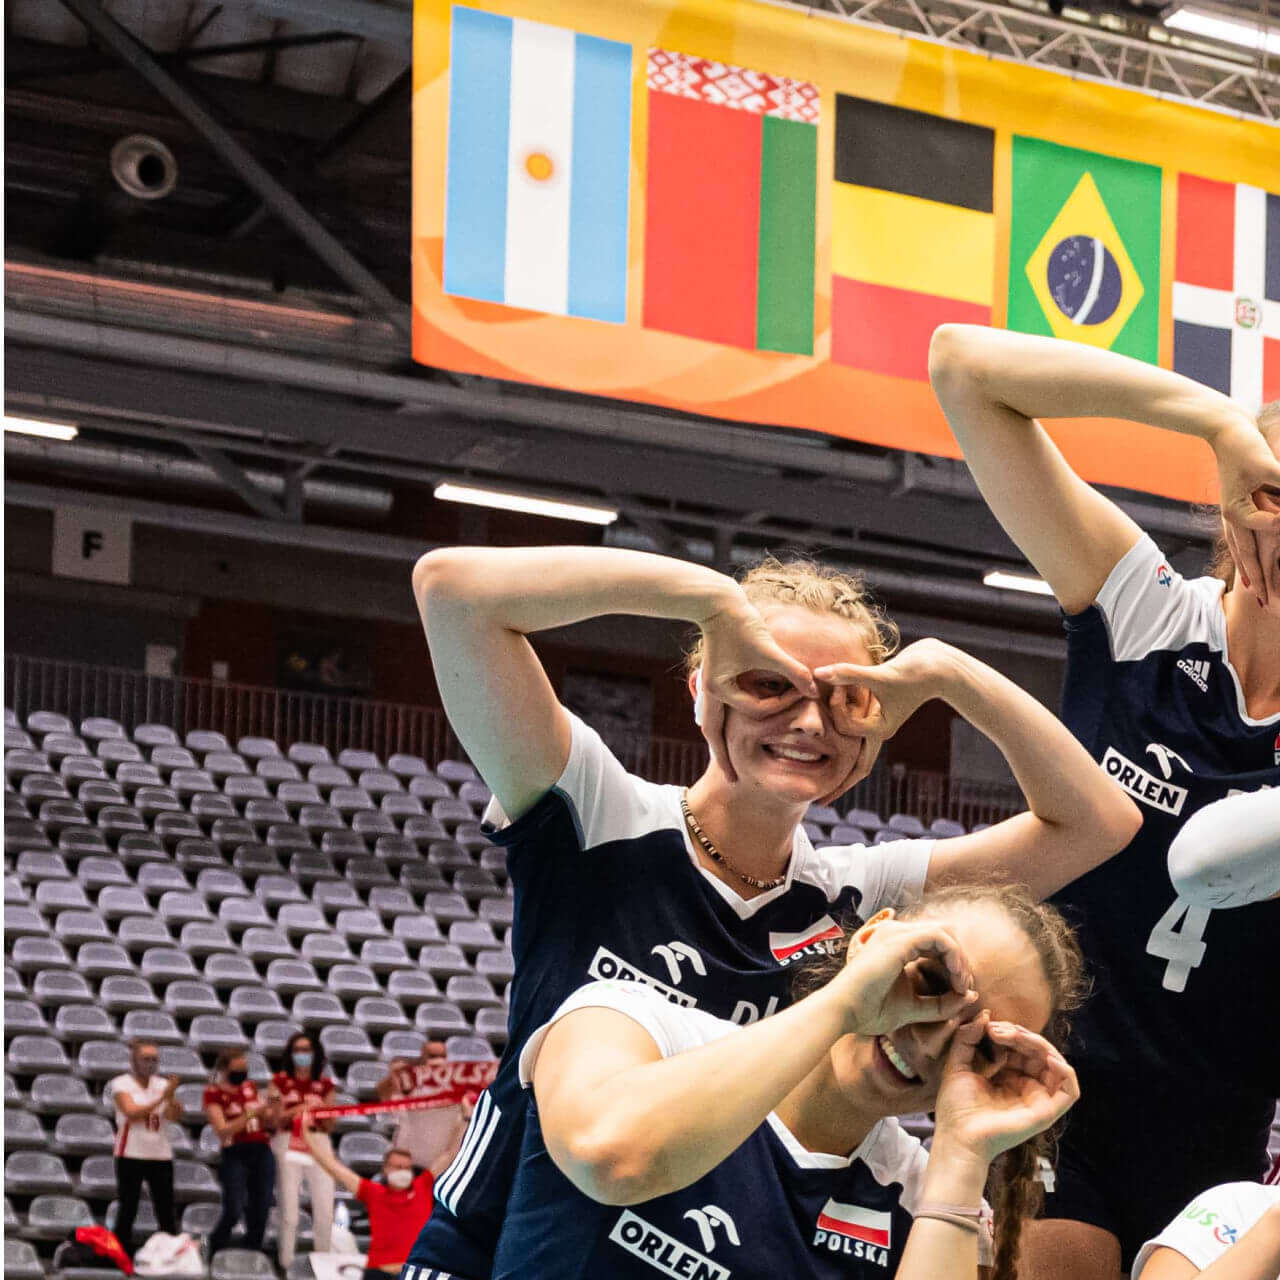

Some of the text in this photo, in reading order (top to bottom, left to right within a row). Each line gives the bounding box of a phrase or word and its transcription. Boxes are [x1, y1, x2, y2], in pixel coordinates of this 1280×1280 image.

[82, 531, 104, 560] F
[1176, 657, 1209, 693] adidas
[1105, 754, 1182, 810] ORLEN
[1145, 902, 1213, 993] 4
[813, 1230, 889, 1268] POLSKA
